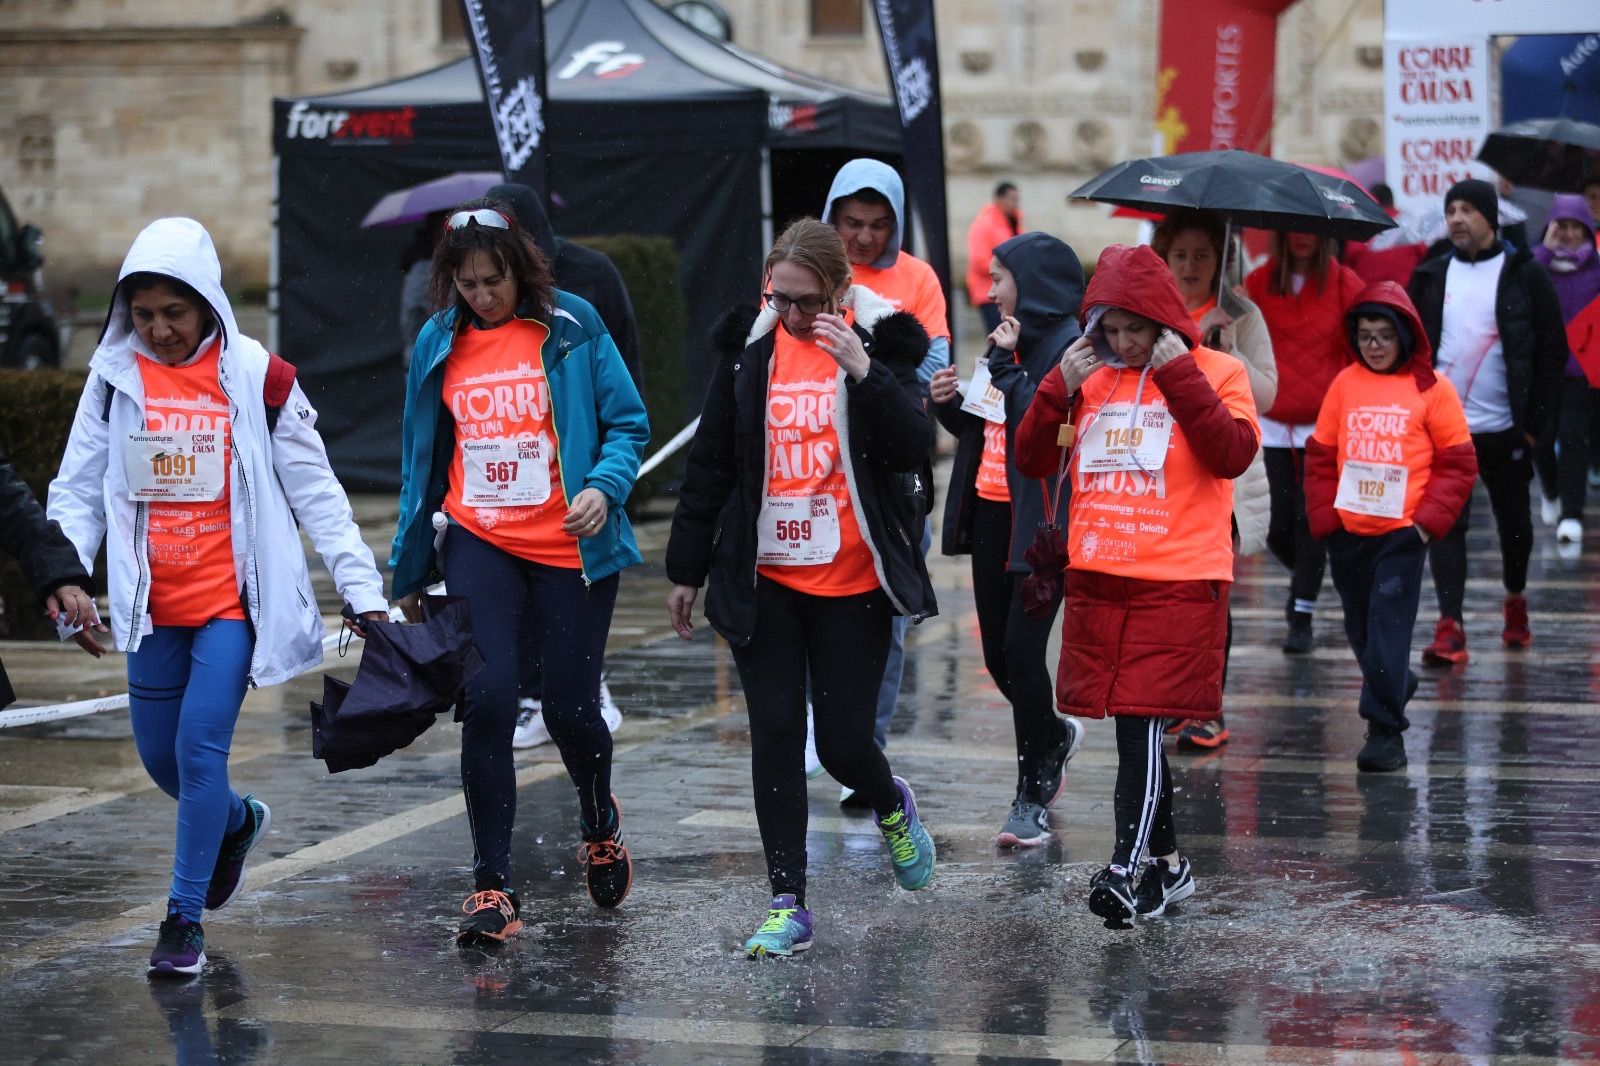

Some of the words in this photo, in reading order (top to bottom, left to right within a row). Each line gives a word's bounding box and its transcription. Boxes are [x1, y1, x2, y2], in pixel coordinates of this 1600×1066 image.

[1399, 47, 1474, 72] CORRE
[1400, 80, 1473, 105] CAUSA
[1401, 139, 1474, 165] CORRE
[1402, 173, 1472, 198] CAUS
[481, 421, 503, 434] UNA
[777, 428, 802, 442] UNA
[1347, 412, 1409, 437] CORRE
[192, 434, 215, 442] CORRE
[518, 441, 540, 450] CORRE
[1105, 427, 1143, 448] 1149
[192, 444, 215, 453] CAUSA
[518, 451, 540, 460] CAUSA
[1346, 440, 1403, 462] CAUSA
[150, 454, 196, 477] 1091
[485, 461, 519, 483] 567
[1358, 480, 1385, 497] 1128
[776, 519, 811, 541] 569
[1114, 521, 1136, 531] GAES
[1140, 522, 1169, 535] Deloitte
